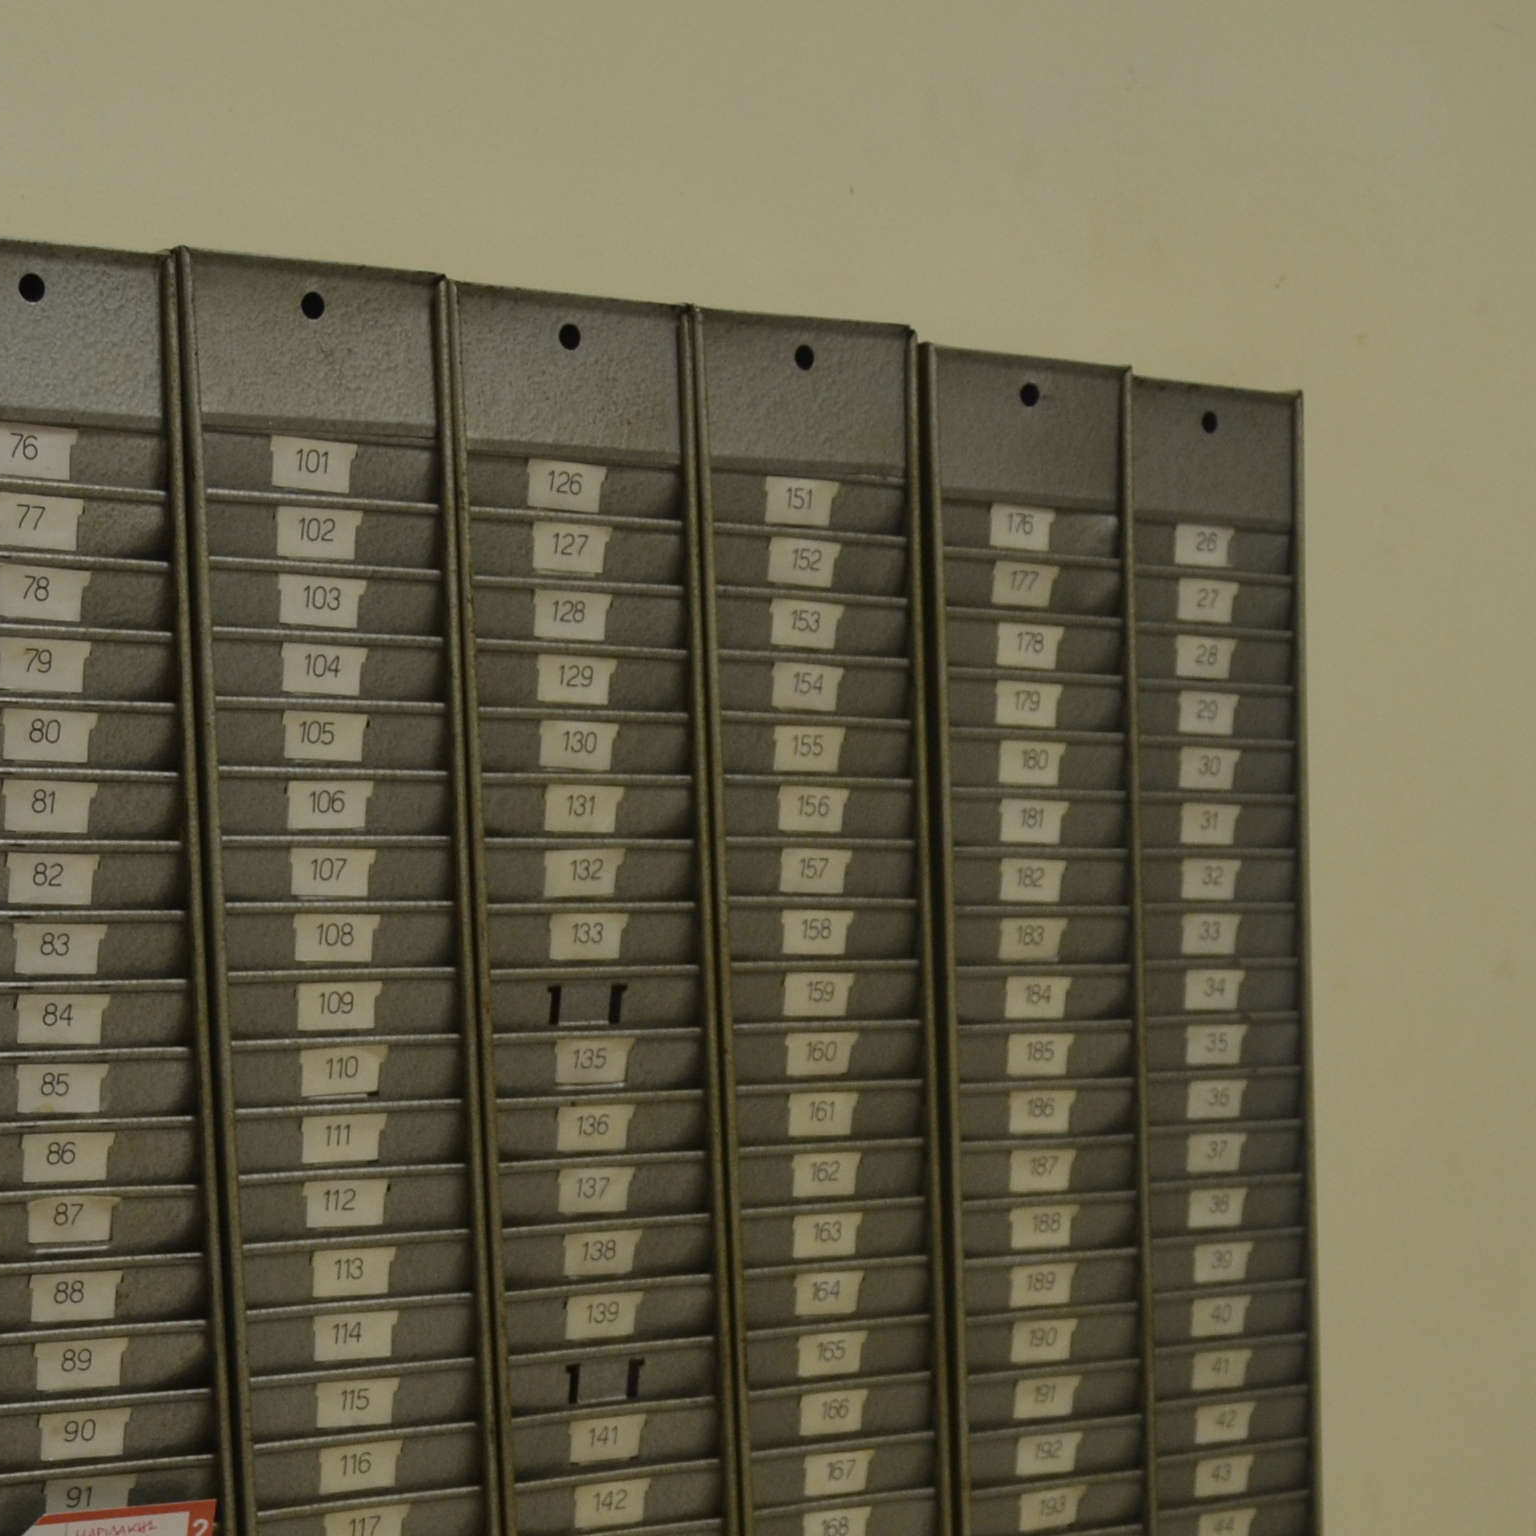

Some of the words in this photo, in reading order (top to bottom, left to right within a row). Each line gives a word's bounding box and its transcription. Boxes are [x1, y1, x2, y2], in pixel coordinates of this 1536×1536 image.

[10, 432, 39, 461] 76
[295, 447, 330, 474] 101
[785, 486, 814, 511] 151
[16, 503, 47, 531] 77
[1007, 512, 1034, 536] 176
[552, 531, 590, 557] 127
[303, 584, 342, 612] 103
[790, 608, 822, 634] 153
[1016, 631, 1045, 655] 178
[24, 647, 53, 675] 79
[305, 653, 341, 679] 104
[558, 664, 595, 689] 129
[791, 733, 824, 758] 155
[1021, 747, 1050, 771] 180
[30, 788, 56, 815] 81
[309, 789, 346, 815] 106
[566, 793, 597, 818] 131
[32, 861, 64, 888] 82
[799, 856, 830, 880] 157
[1016, 866, 1046, 889] 182
[316, 922, 355, 947] 108
[571, 921, 605, 945] 133
[1024, 983, 1052, 1006] 184
[41, 1002, 74, 1028] 84
[806, 1039, 838, 1063] 160
[325, 1055, 360, 1080] 110
[576, 1113, 610, 1138] 136
[45, 1140, 77, 1166] 86
[1030, 1155, 1060, 1178] 187
[323, 1187, 357, 1212] 112
[812, 1220, 843, 1244] 163
[582, 1238, 617, 1262] 138
[52, 1279, 85, 1305] 88
[333, 1321, 362, 1344] 114
[822, 1397, 850, 1421] 166
[64, 1419, 96, 1443] 90
[588, 1425, 619, 1448] 141
[340, 1451, 372, 1476] 116
[65, 1485, 93, 1510] 91
